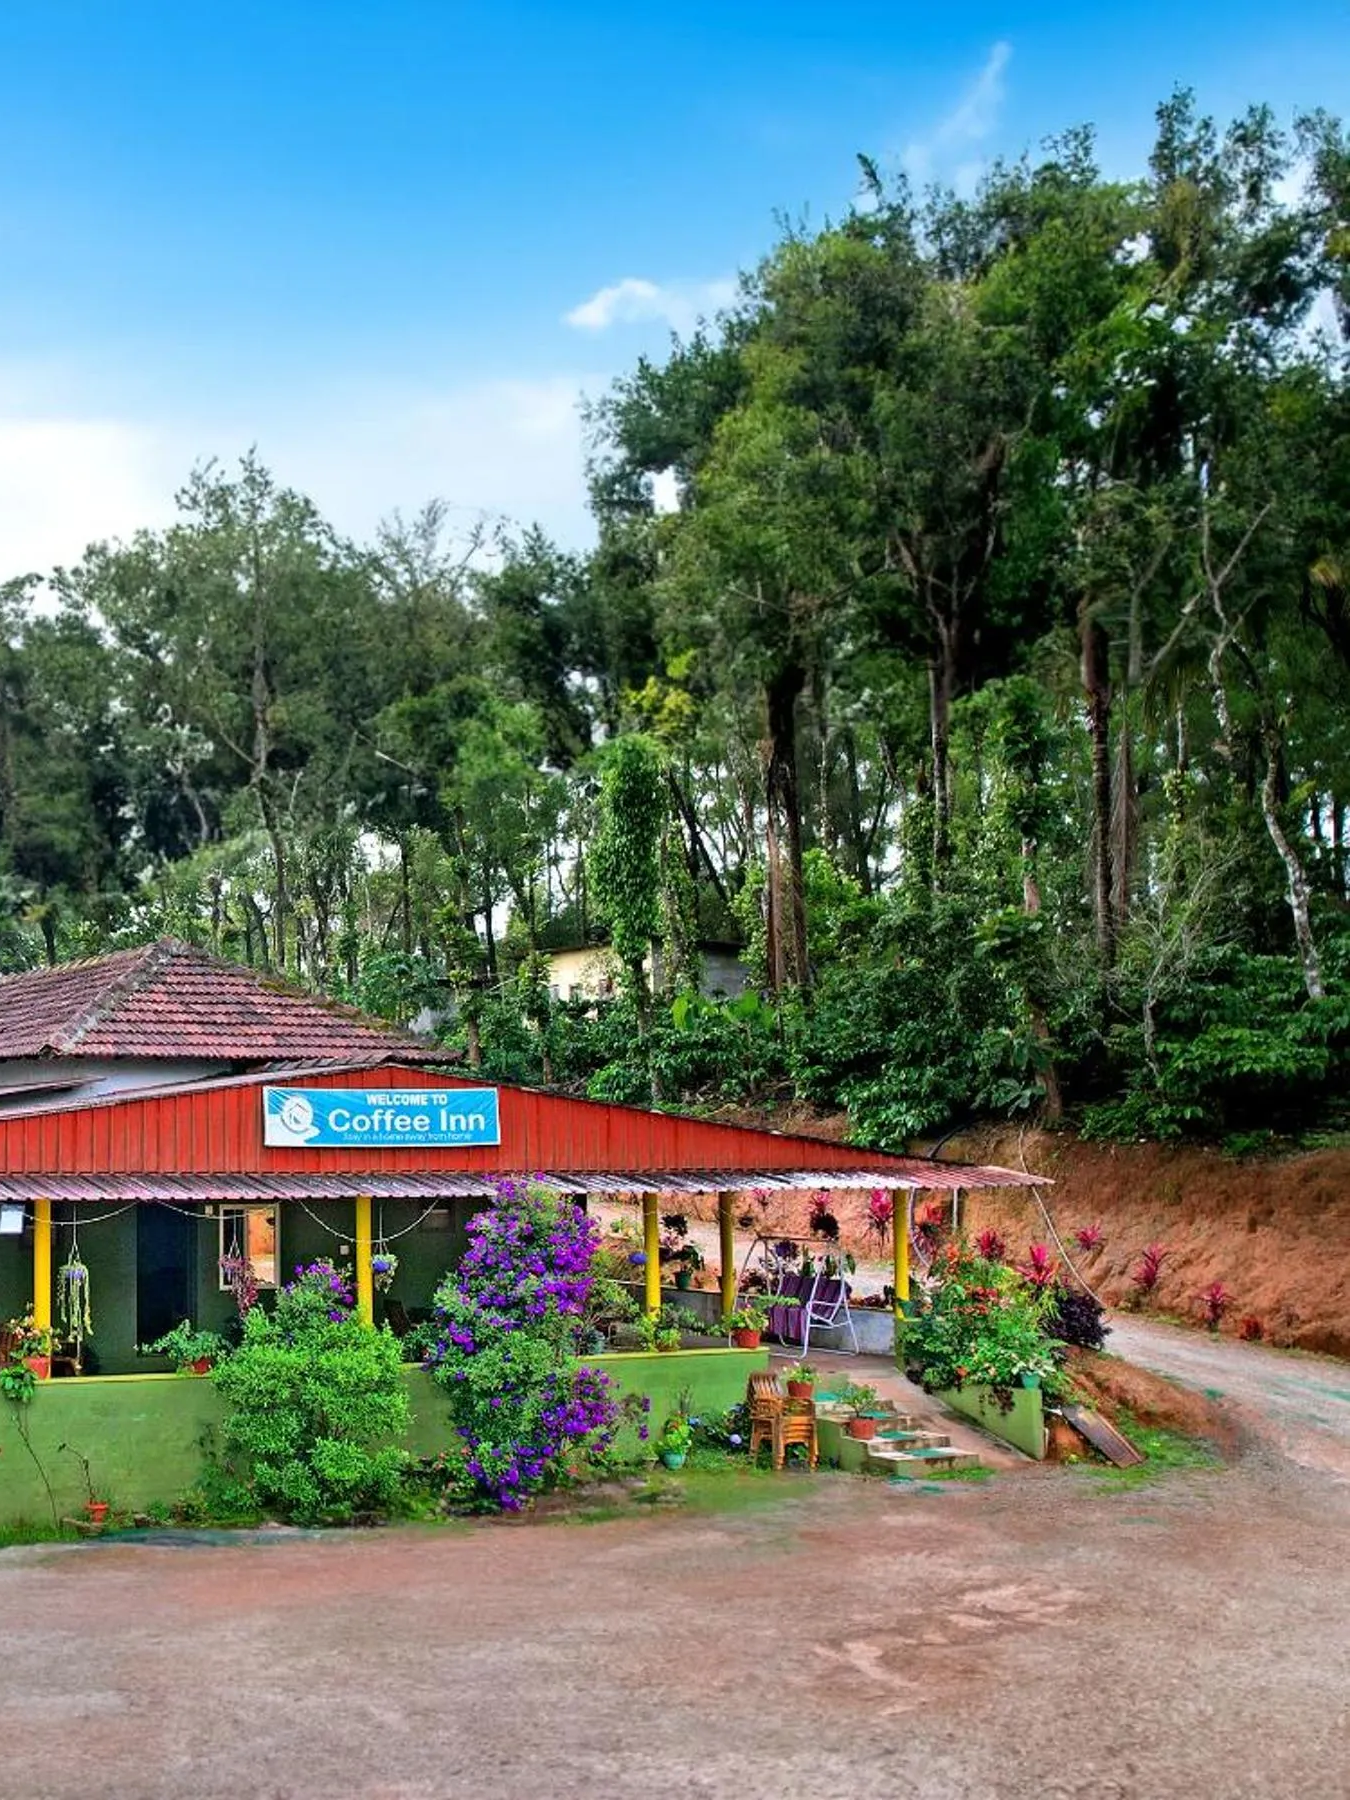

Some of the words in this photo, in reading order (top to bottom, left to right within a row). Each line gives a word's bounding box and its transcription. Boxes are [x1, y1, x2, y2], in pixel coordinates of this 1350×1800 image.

[366, 1094, 428, 1106] WELCOME
[432, 1093, 448, 1105] TO
[328, 1108, 431, 1132] Coffee
[440, 1108, 486, 1132] Inn
